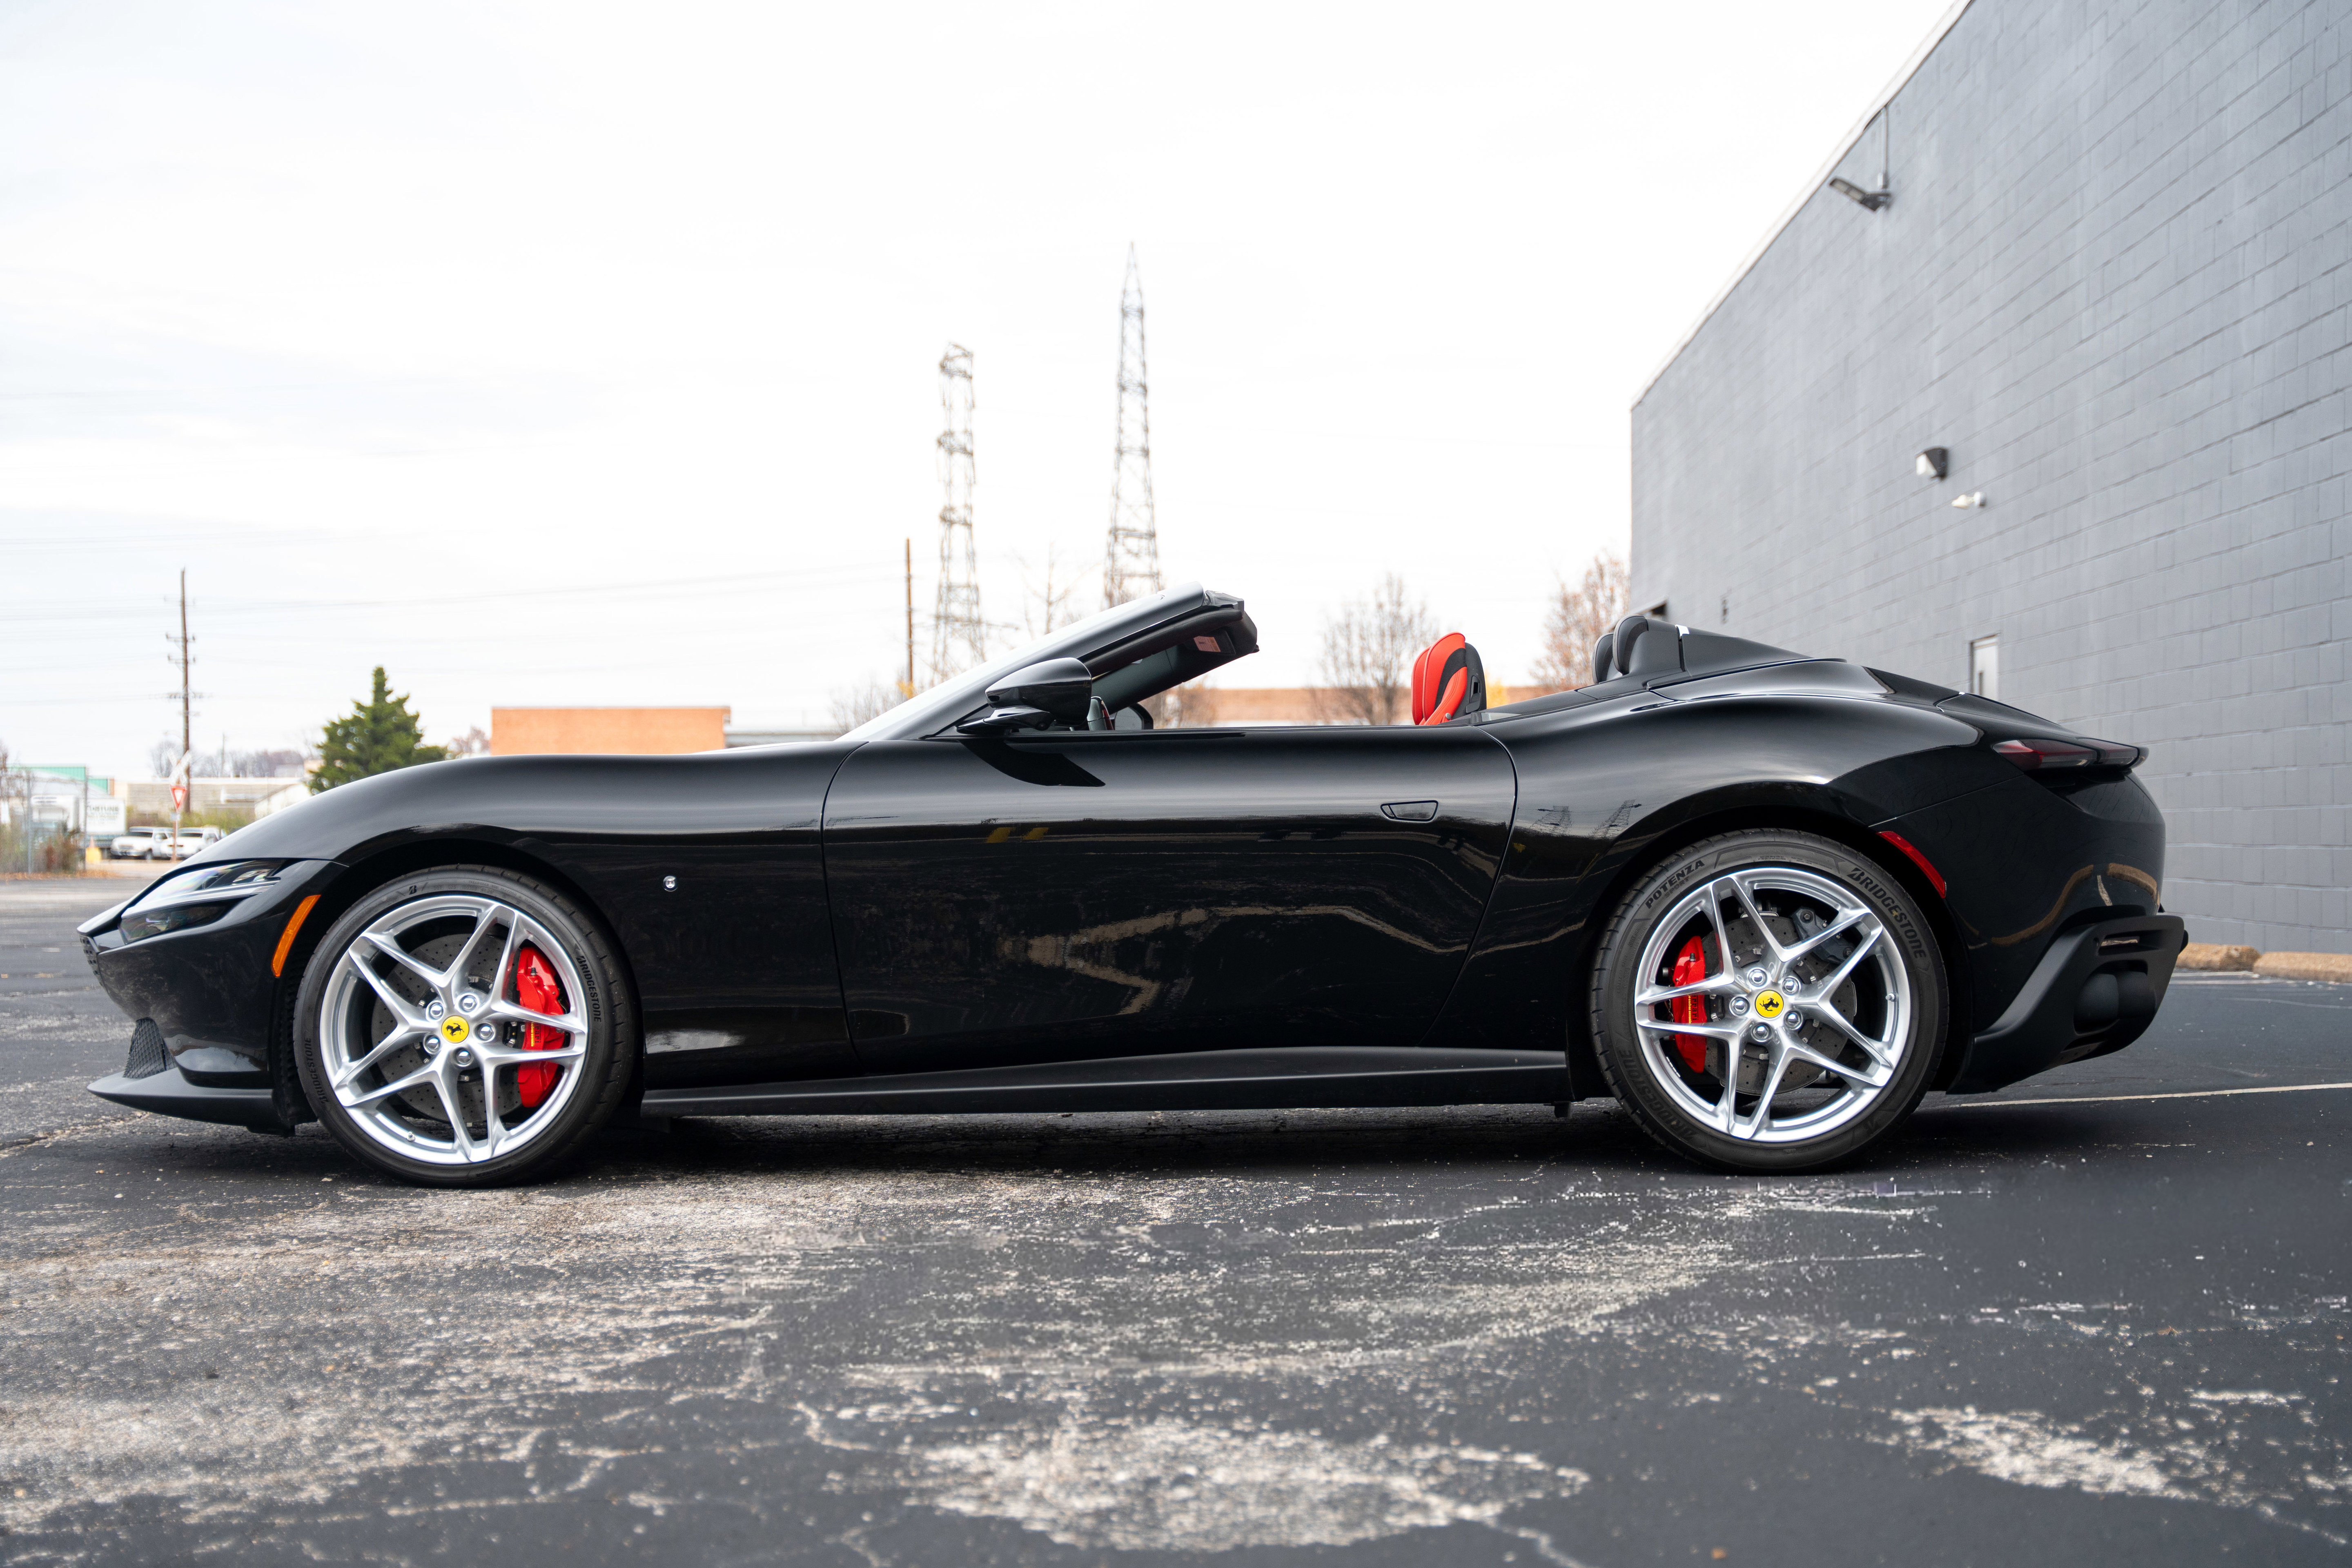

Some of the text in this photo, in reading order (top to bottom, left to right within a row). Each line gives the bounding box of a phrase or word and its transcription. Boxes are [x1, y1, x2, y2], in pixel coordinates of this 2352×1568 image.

[1645, 860, 1705, 909] POTENZA
[1665, 877, 1690, 898] SPORT
[1847, 867, 1927, 959] BRIDGESTONE
[575, 955, 602, 1022] BRIDGESTONE
[304, 1037, 329, 1105] BRIDGESTONE
[1619, 1049, 1697, 1143] BRIDGESTONE
